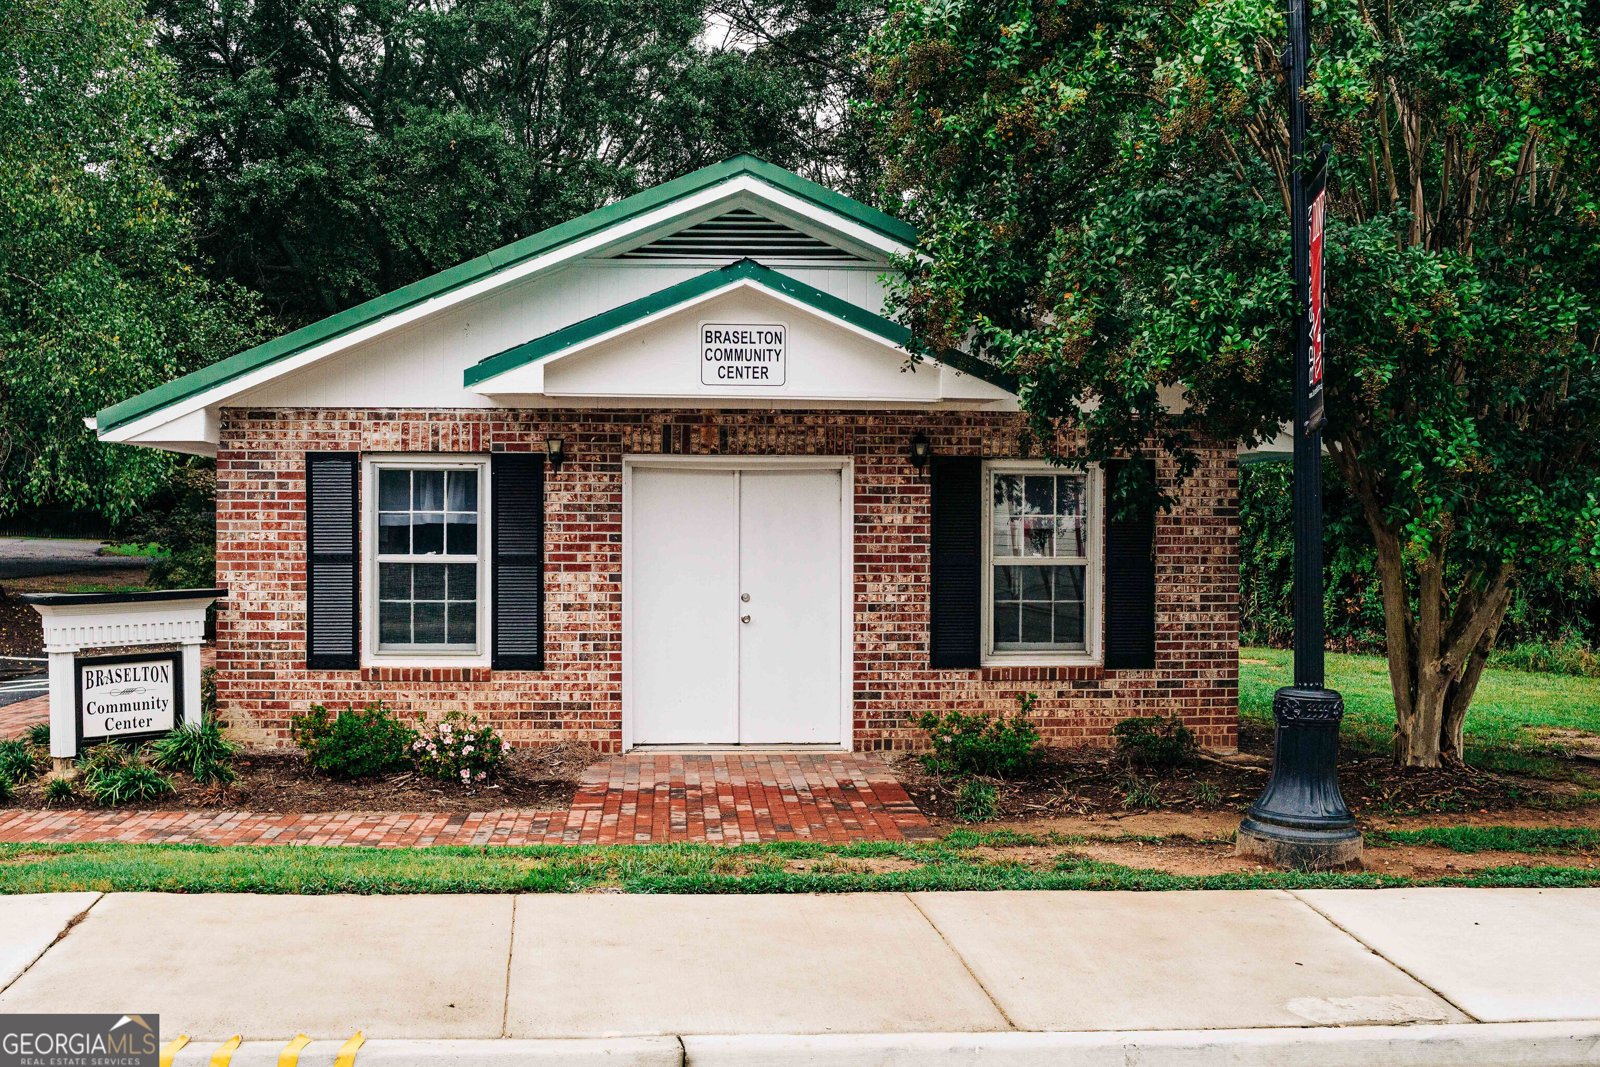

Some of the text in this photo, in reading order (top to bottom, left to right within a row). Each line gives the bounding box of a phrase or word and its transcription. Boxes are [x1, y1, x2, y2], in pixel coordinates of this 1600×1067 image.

[705, 330, 783, 345] BRASELTON
[705, 348, 782, 362] COMMUNITY
[717, 365, 769, 379] CENTER
[85, 665, 169, 690] BRASELTON
[86, 696, 169, 716] Community
[104, 717, 153, 731] Center
